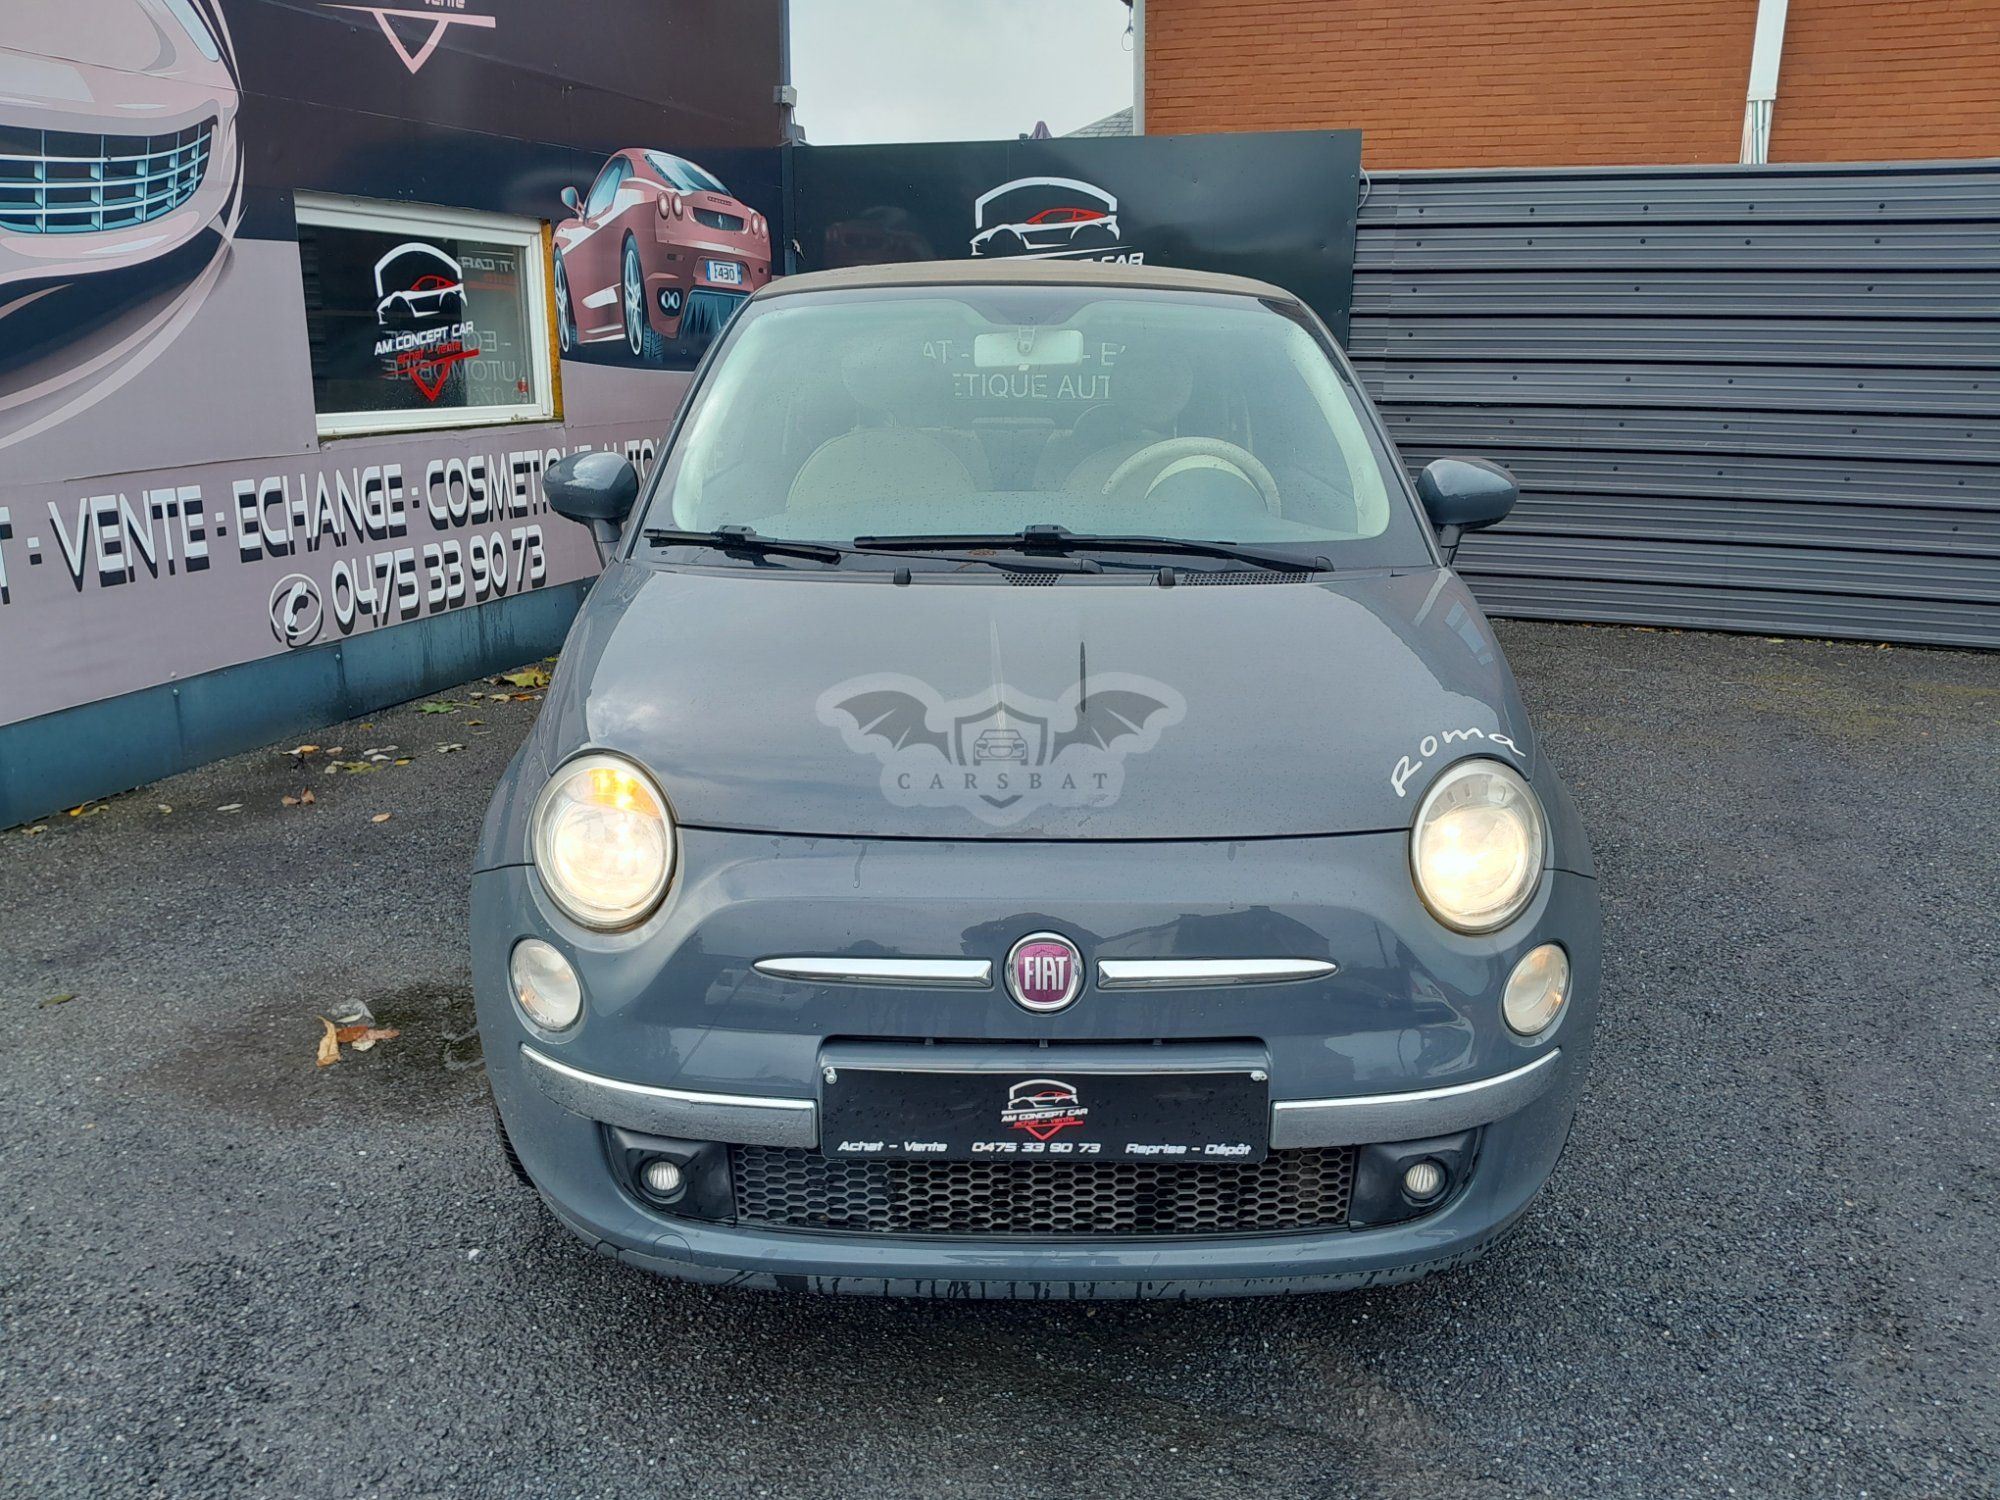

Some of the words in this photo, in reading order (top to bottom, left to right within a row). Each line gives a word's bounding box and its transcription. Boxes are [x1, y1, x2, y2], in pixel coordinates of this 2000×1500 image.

[374, 340, 393, 356] AM
[395, 326, 449, 350] CONCEPT
[451, 321, 474, 338] CAR
[47, 484, 210, 592] VENTE
[233, 464, 407, 563] ECHANGE
[426, 445, 592, 530] COSMETI
[332, 548, 420, 634] 0475
[423, 540, 466, 614] 33
[469, 531, 508, 602] 90
[511, 524, 547, 592] 73
[1391, 727, 1526, 797] Roma
[1024, 956, 1068, 991] FIAT
[1067, 1108, 1089, 1117] CAR
[838, 1141, 884, 1152] Achat
[903, 1141, 948, 1152] Vente
[971, 1142, 1017, 1153] 0475
[1021, 1142, 1046, 1153] 33
[1049, 1143, 1073, 1153] 90
[1078, 1143, 1101, 1153] 73
[1125, 1143, 1187, 1155] Reprise
[1204, 1143, 1251, 1155] Dépôt
